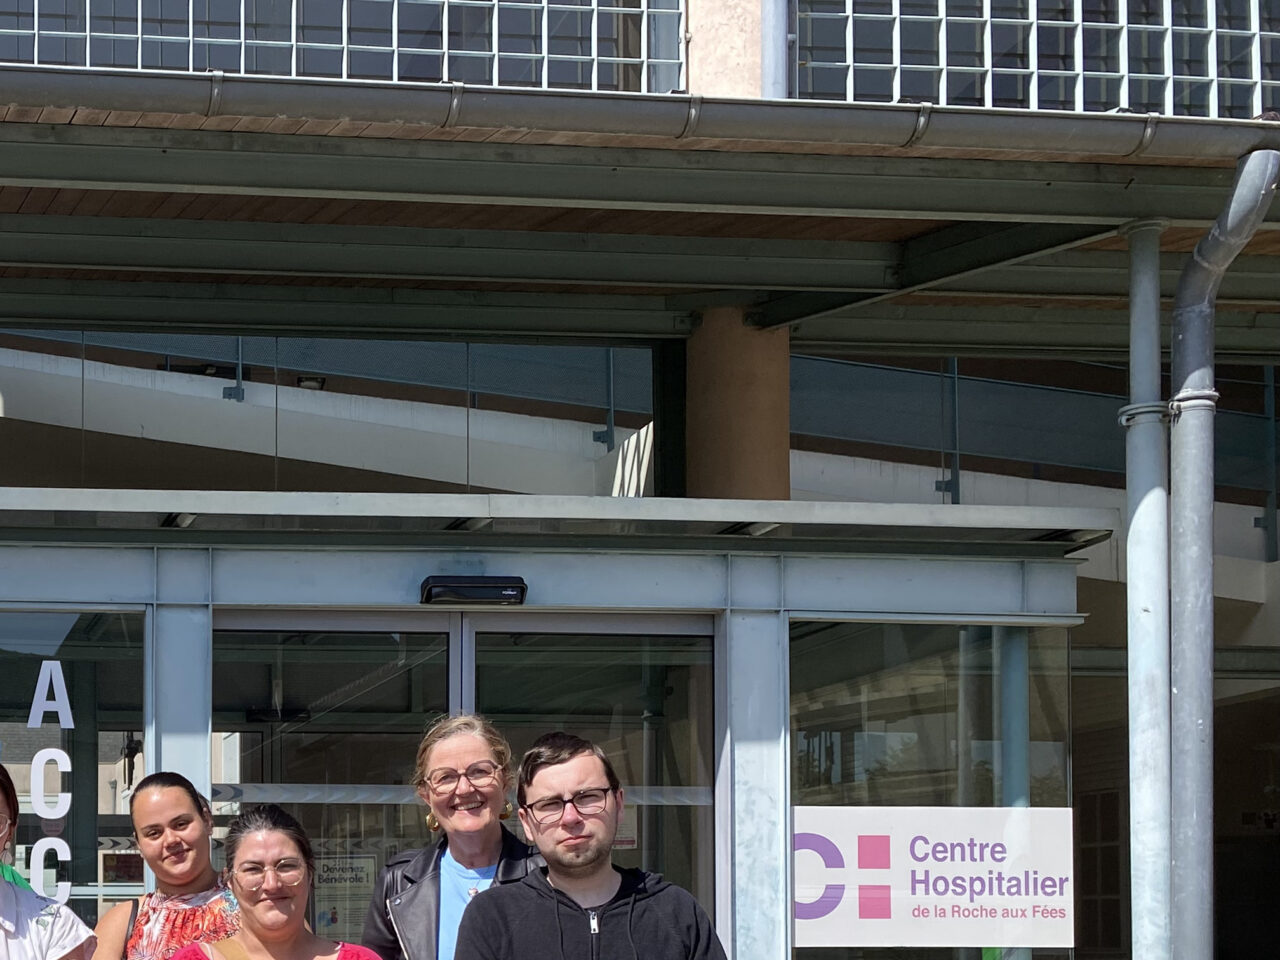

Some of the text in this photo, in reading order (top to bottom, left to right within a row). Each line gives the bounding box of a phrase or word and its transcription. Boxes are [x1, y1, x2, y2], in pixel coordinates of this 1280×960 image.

[909, 835, 1007, 862] Centre
[323, 864, 365, 873] Devenez
[318, 873, 364, 884] Bénévole
[910, 869, 1069, 903] Hospitalier
[912, 905, 1066, 919] de la Roche aux Fées
